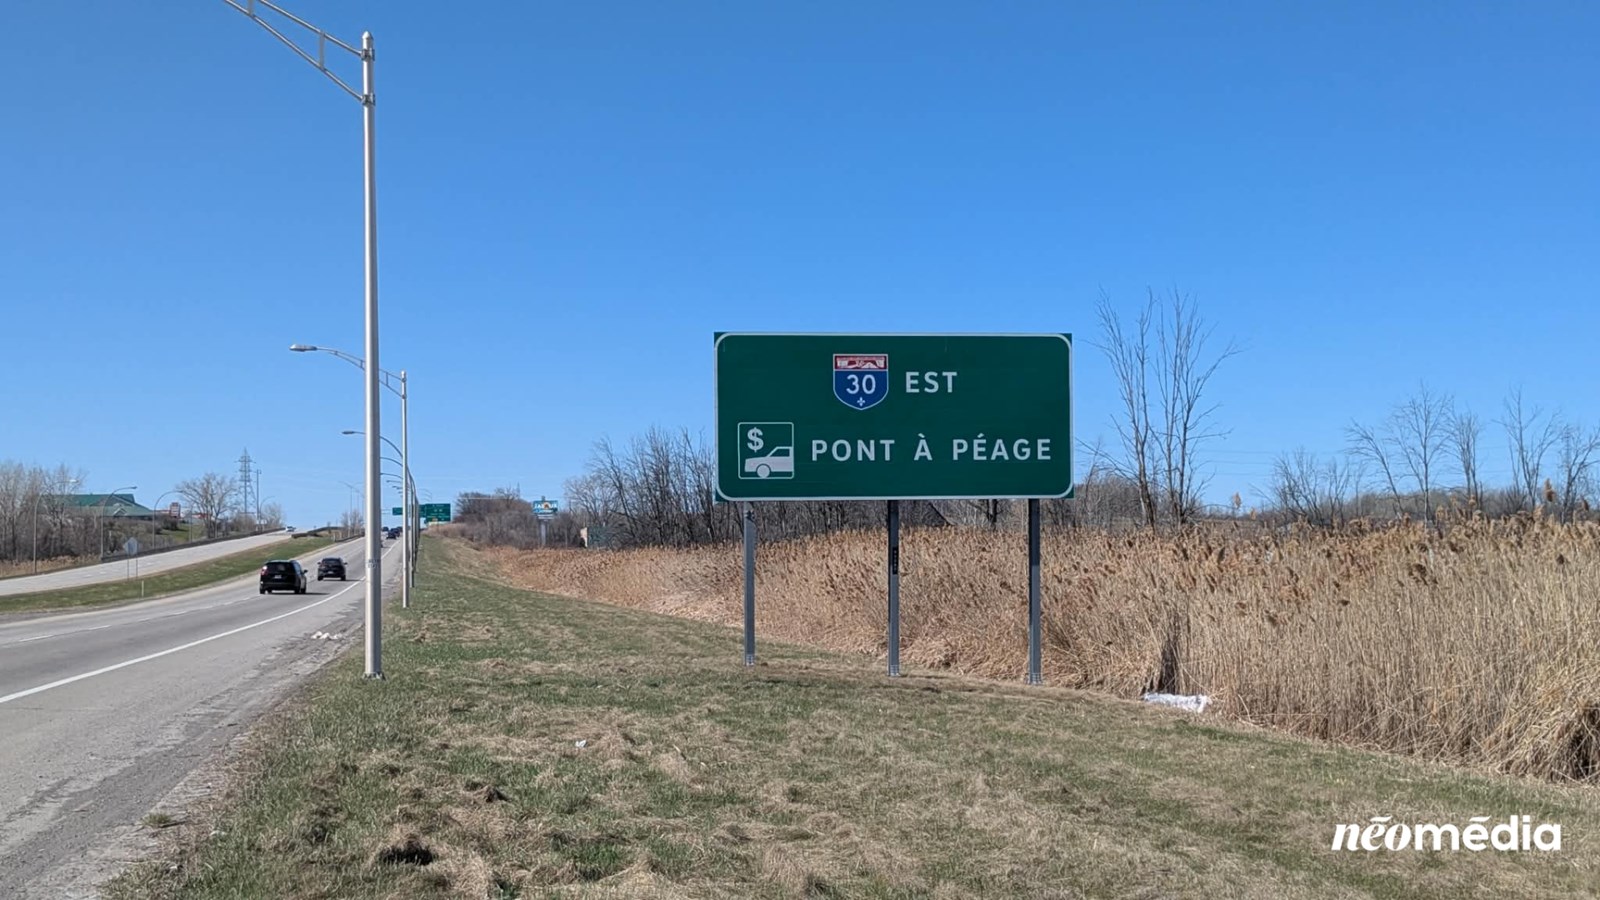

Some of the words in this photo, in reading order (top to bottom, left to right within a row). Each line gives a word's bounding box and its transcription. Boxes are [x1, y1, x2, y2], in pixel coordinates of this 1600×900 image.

[846, 374, 876, 395] 30
[905, 371, 958, 393] EST
[811, 439, 895, 461] PONT
[913, 433, 933, 461] À
[952, 433, 1051, 461] PÉAGE
